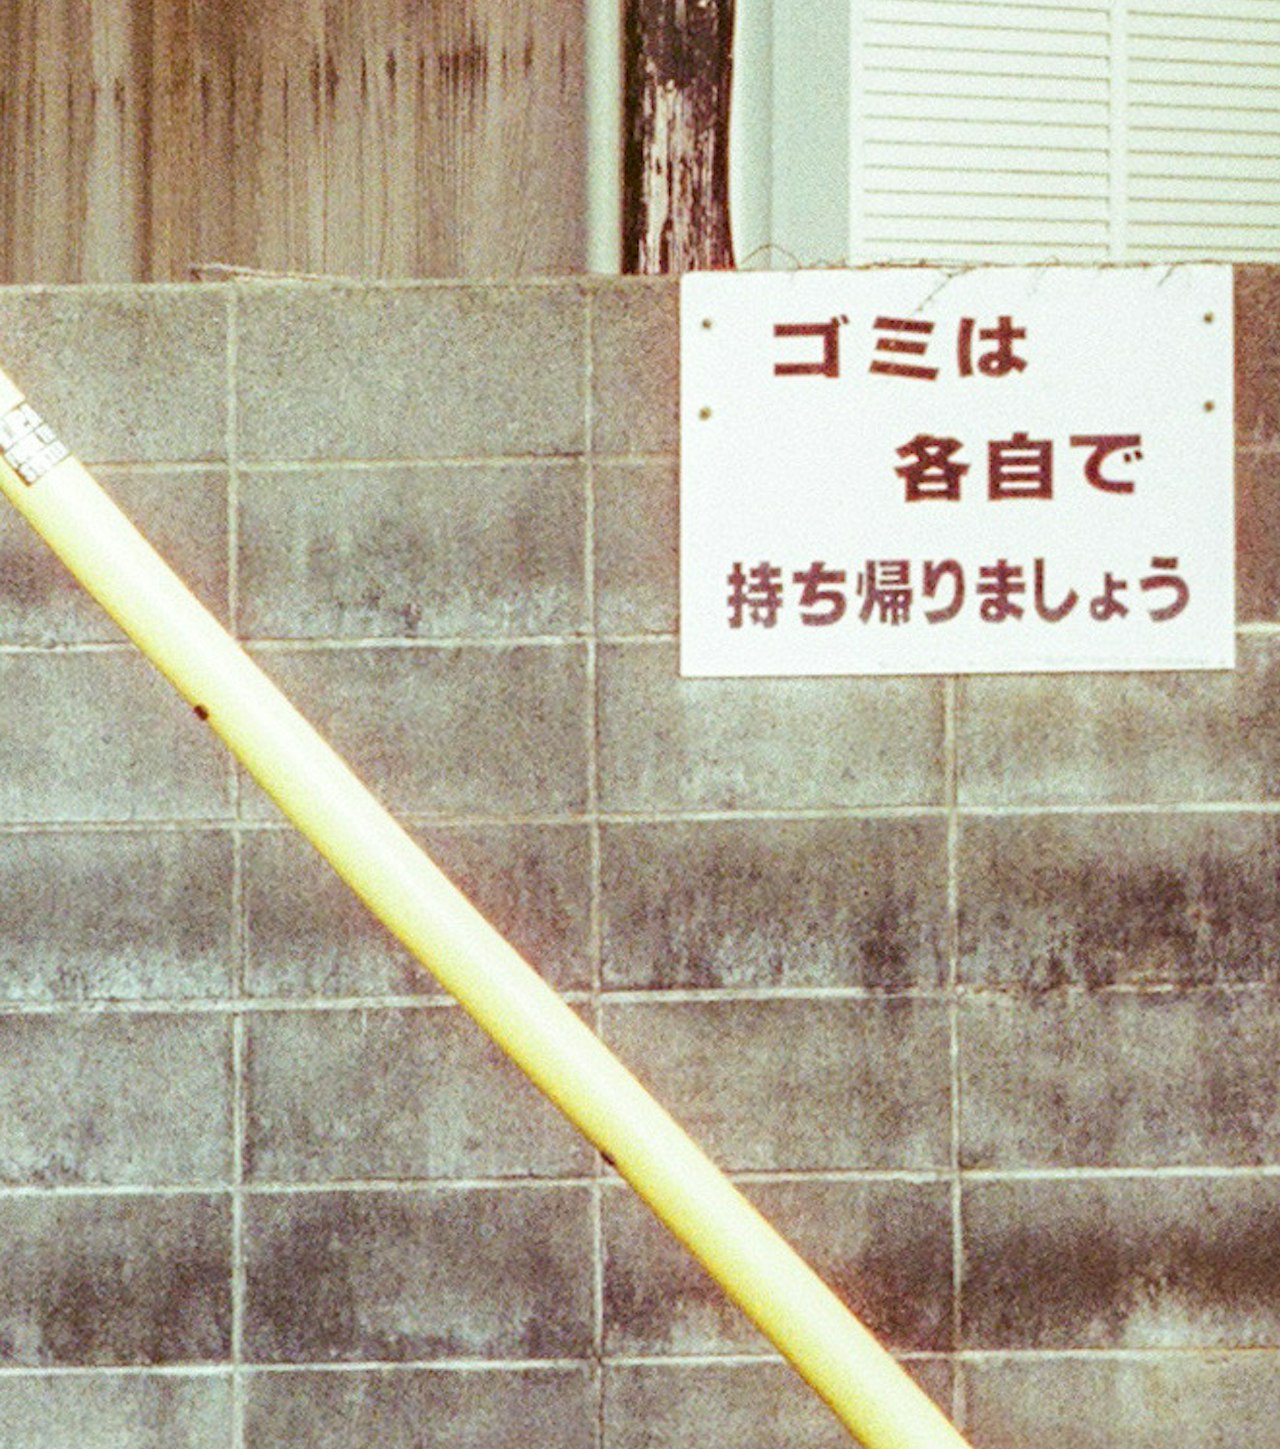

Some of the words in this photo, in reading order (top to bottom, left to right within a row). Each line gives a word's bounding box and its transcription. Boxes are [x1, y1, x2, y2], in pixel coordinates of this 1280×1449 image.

[772, 314, 1028, 381] ゴミは
[895, 432, 1143, 503] 各自で
[727, 556, 1190, 628] 持ち帰りましょう
